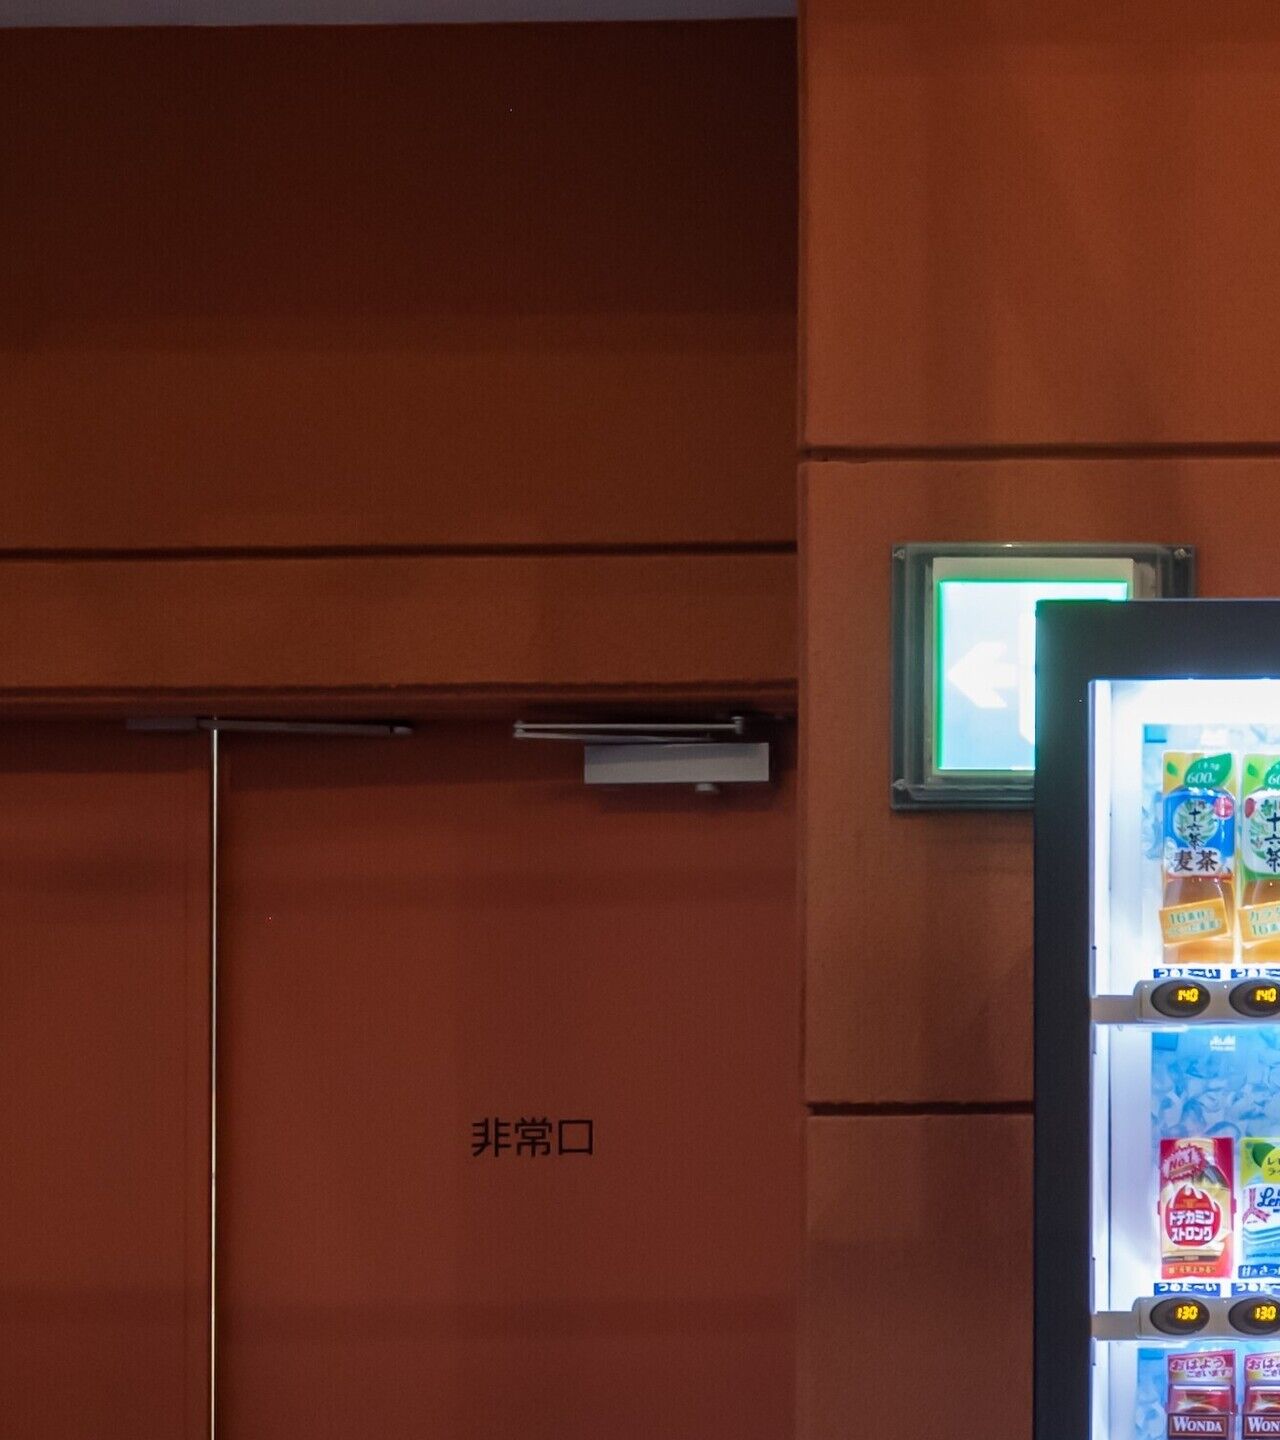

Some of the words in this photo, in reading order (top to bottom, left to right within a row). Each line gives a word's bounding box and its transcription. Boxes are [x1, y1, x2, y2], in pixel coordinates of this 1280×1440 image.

[1174, 849, 1218, 872] 麦茶
[1177, 988, 1199, 1002] 140
[1256, 987, 1277, 1002] 140
[472, 1117, 593, 1158] 非常口
[1169, 1210, 1215, 1226] ドデカミン
[1170, 1225, 1213, 1242] ストロング
[1177, 1305, 1198, 1320] 130
[1255, 1305, 1277, 1320] 130
[1170, 1358, 1225, 1371] おはよう
[1173, 1415, 1222, 1432] WONDA
